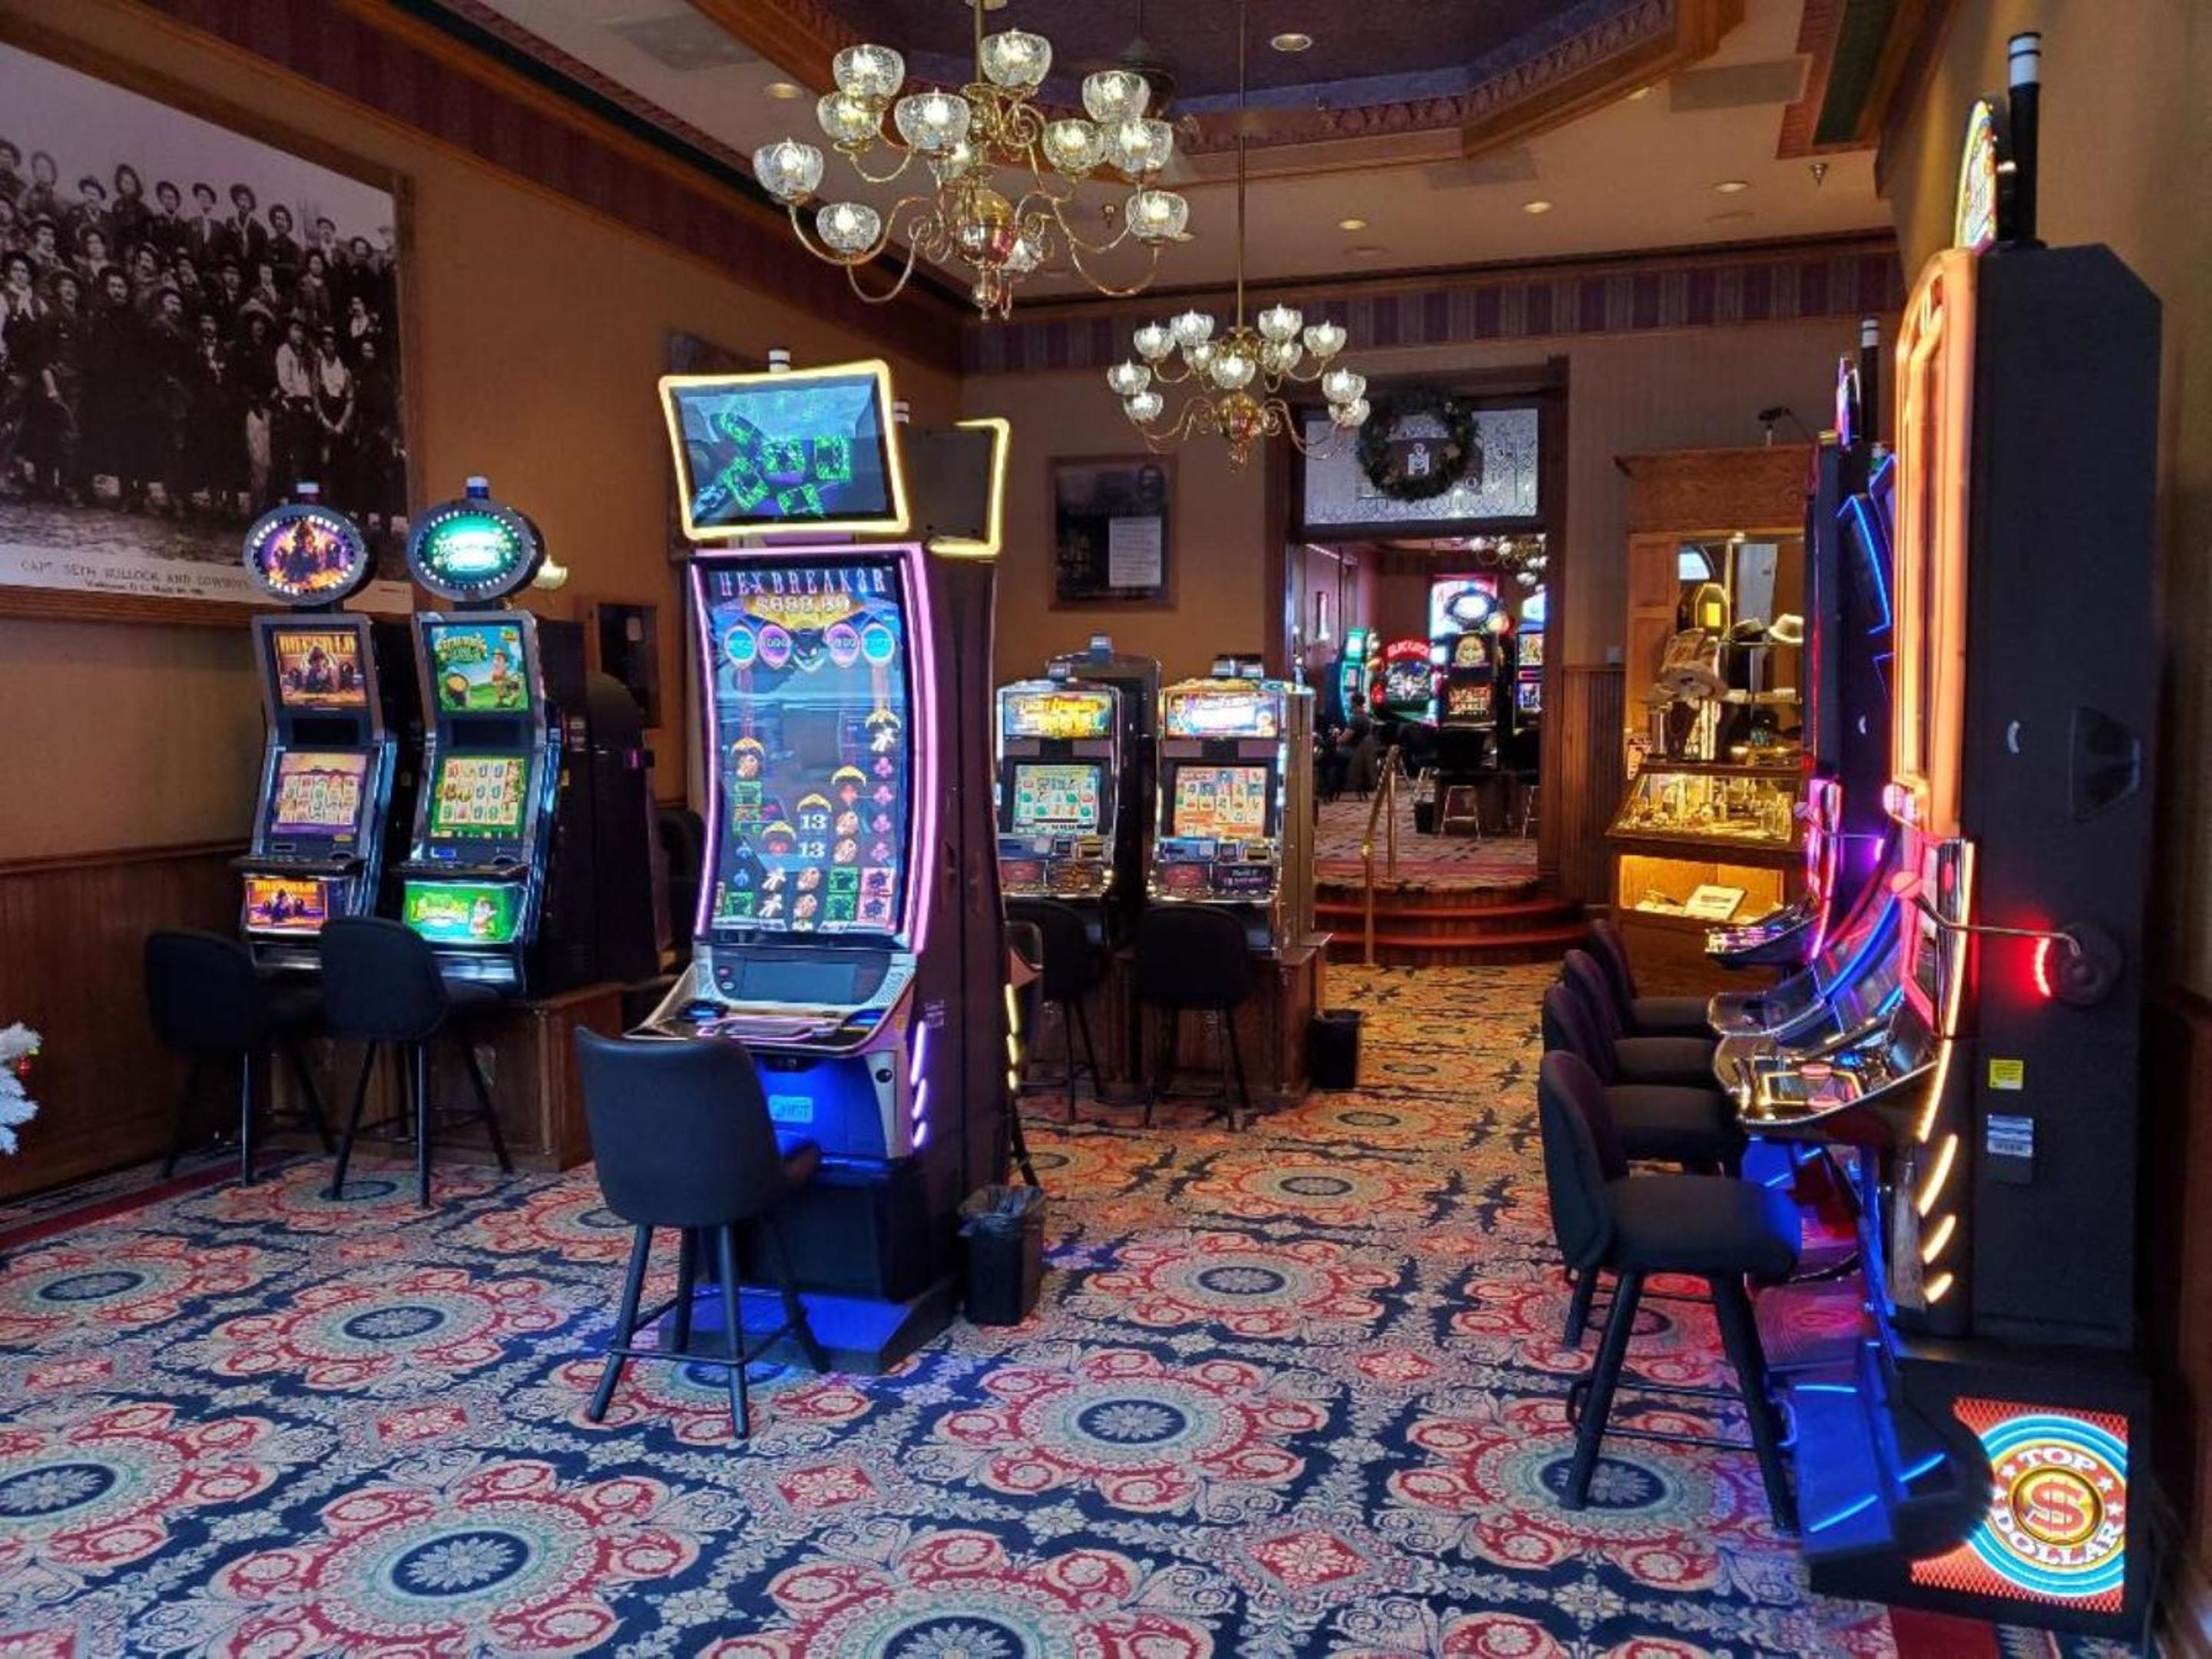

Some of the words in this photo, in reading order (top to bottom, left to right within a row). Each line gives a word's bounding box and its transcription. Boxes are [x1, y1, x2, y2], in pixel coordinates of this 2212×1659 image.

[798, 813, 827, 830] 13
[796, 841, 826, 859] 13
[2017, 1445, 2098, 1472] TOP
[1988, 1507, 2126, 1565] DOLLAR
